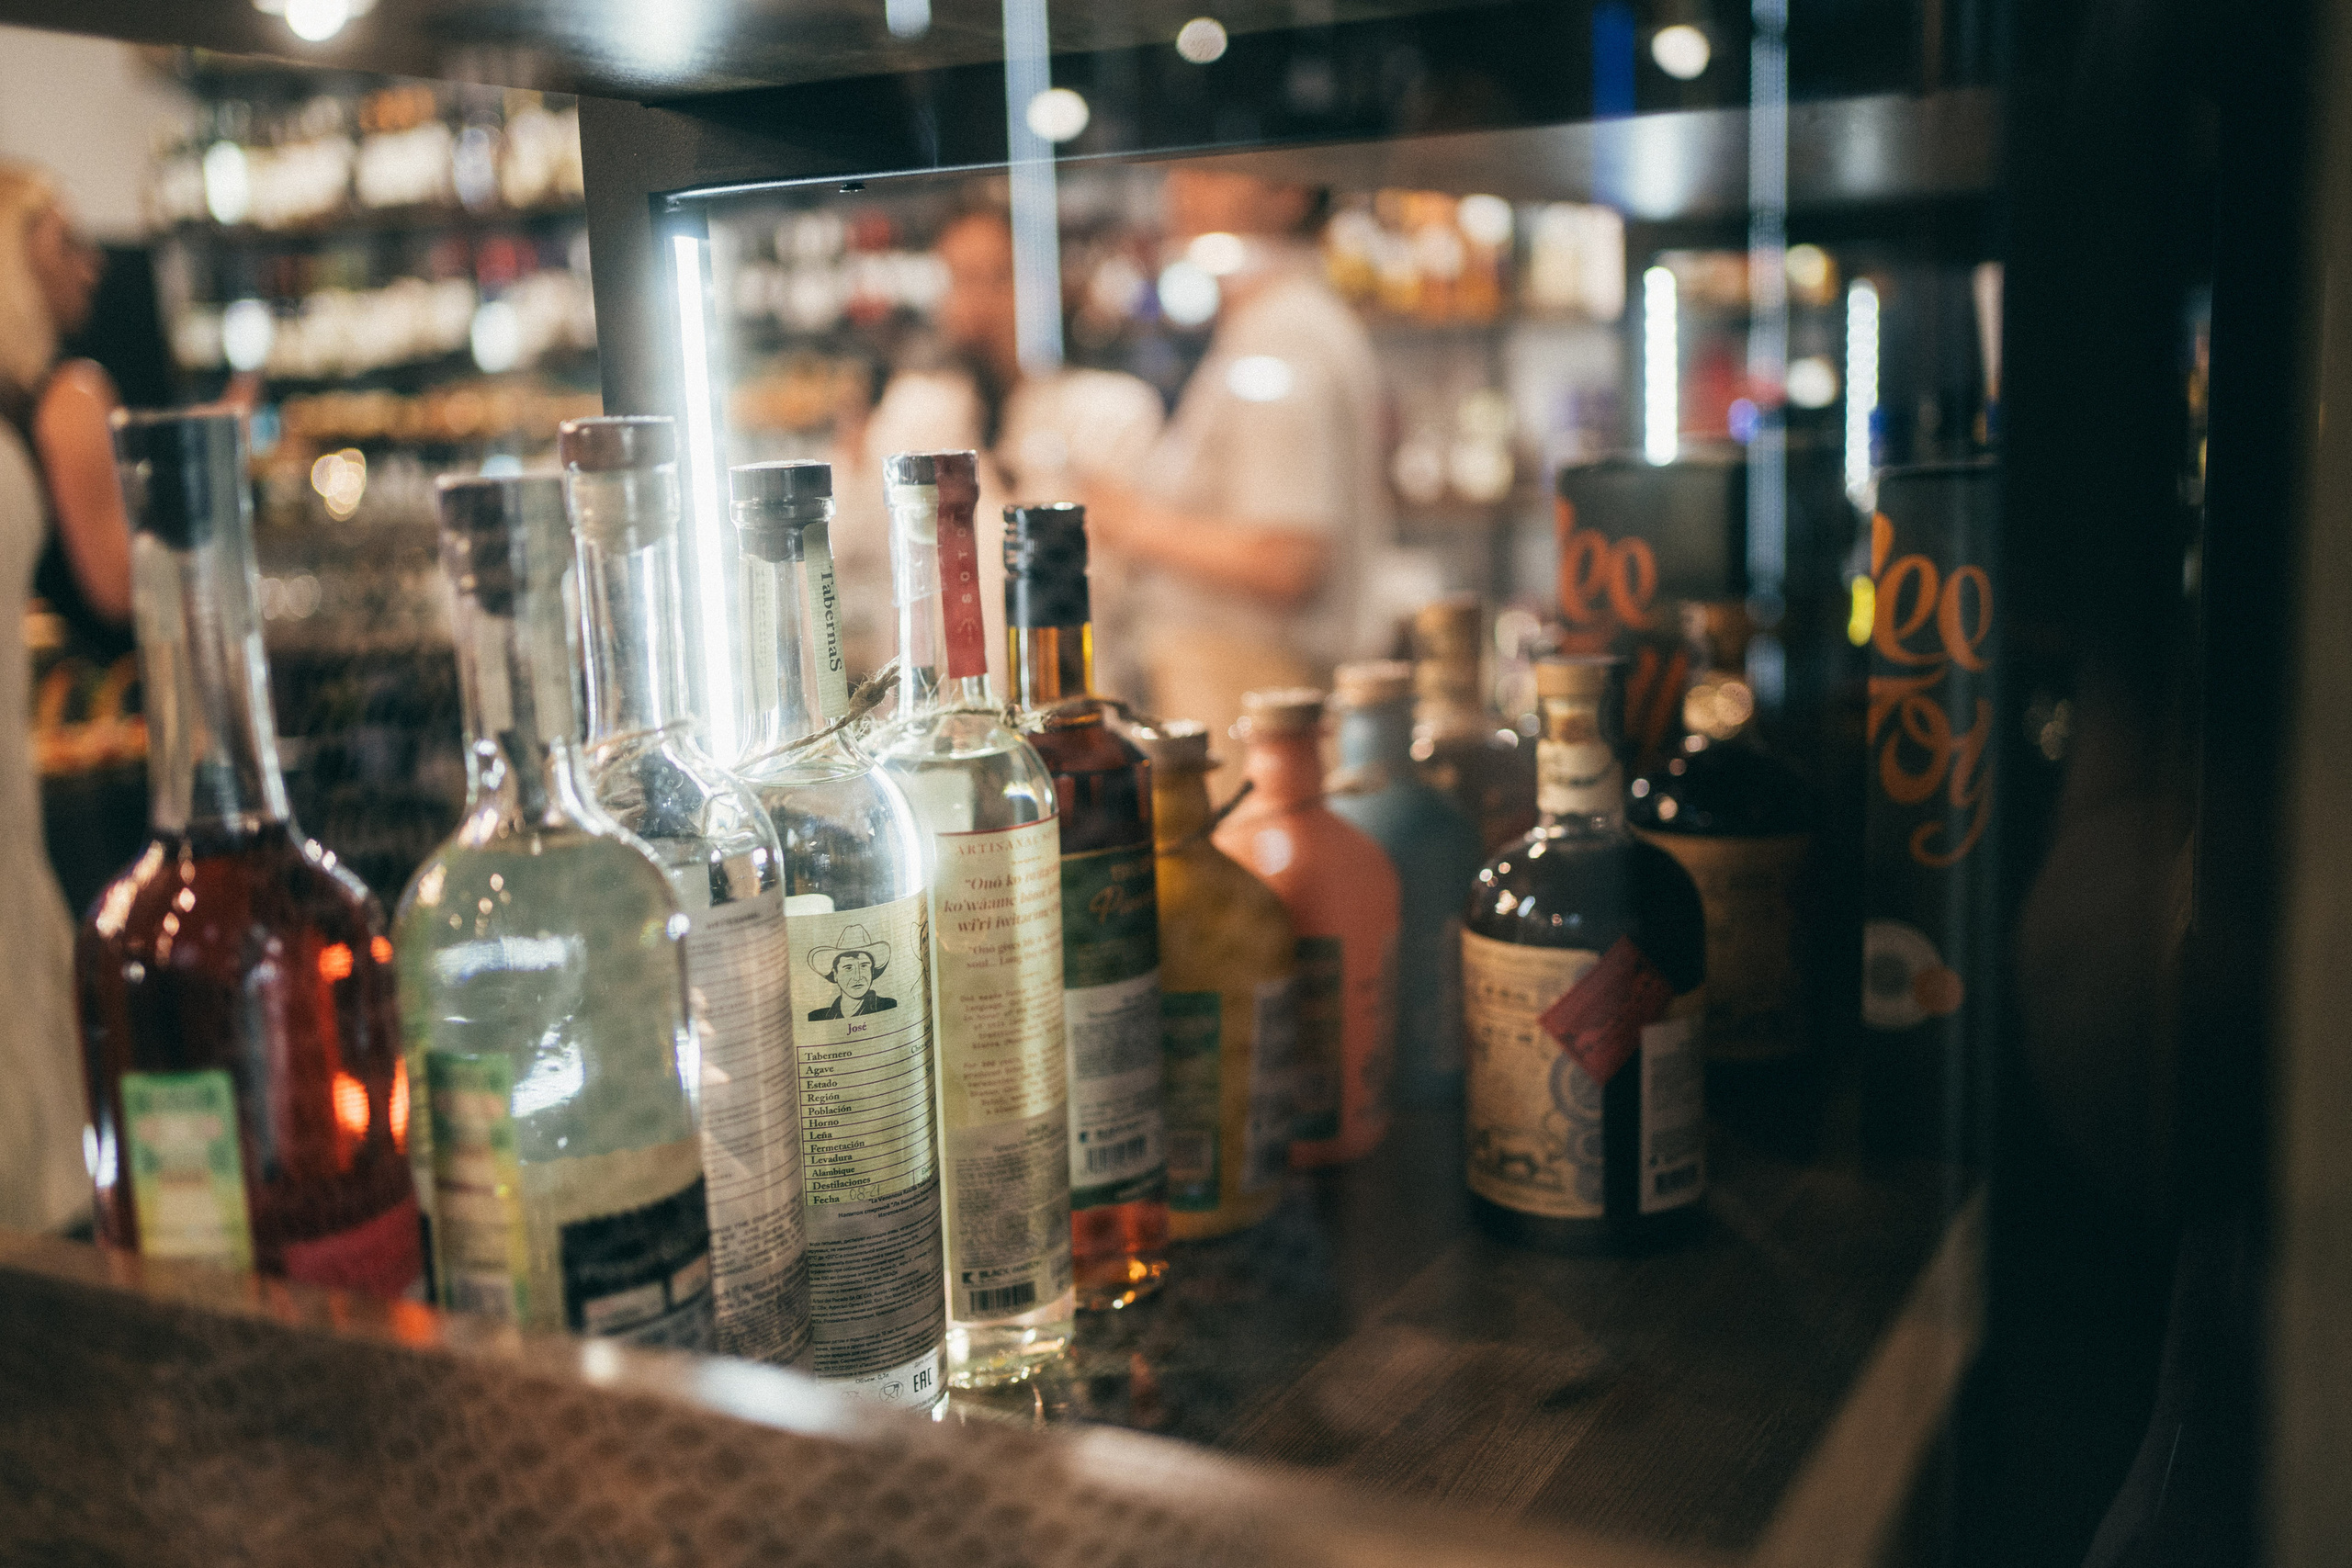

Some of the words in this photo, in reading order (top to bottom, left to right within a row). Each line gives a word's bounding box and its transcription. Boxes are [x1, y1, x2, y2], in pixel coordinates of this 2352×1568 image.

[846, 1021, 867, 1036] José
[804, 1051, 853, 1061] Tabernero
[806, 1066, 834, 1077] Agave
[807, 1079, 838, 1089] Estado
[808, 1093, 840, 1104] Región
[808, 1104, 853, 1116] Población
[808, 1119, 840, 1128] Horno
[809, 1131, 833, 1140] Leña
[810, 1140, 865, 1153] Fermetación
[811, 1154, 853, 1164] Levadura
[811, 1167, 855, 1177] Alambique
[812, 1178, 871, 1190] Destilaciones
[813, 1195, 840, 1204] Fecha
